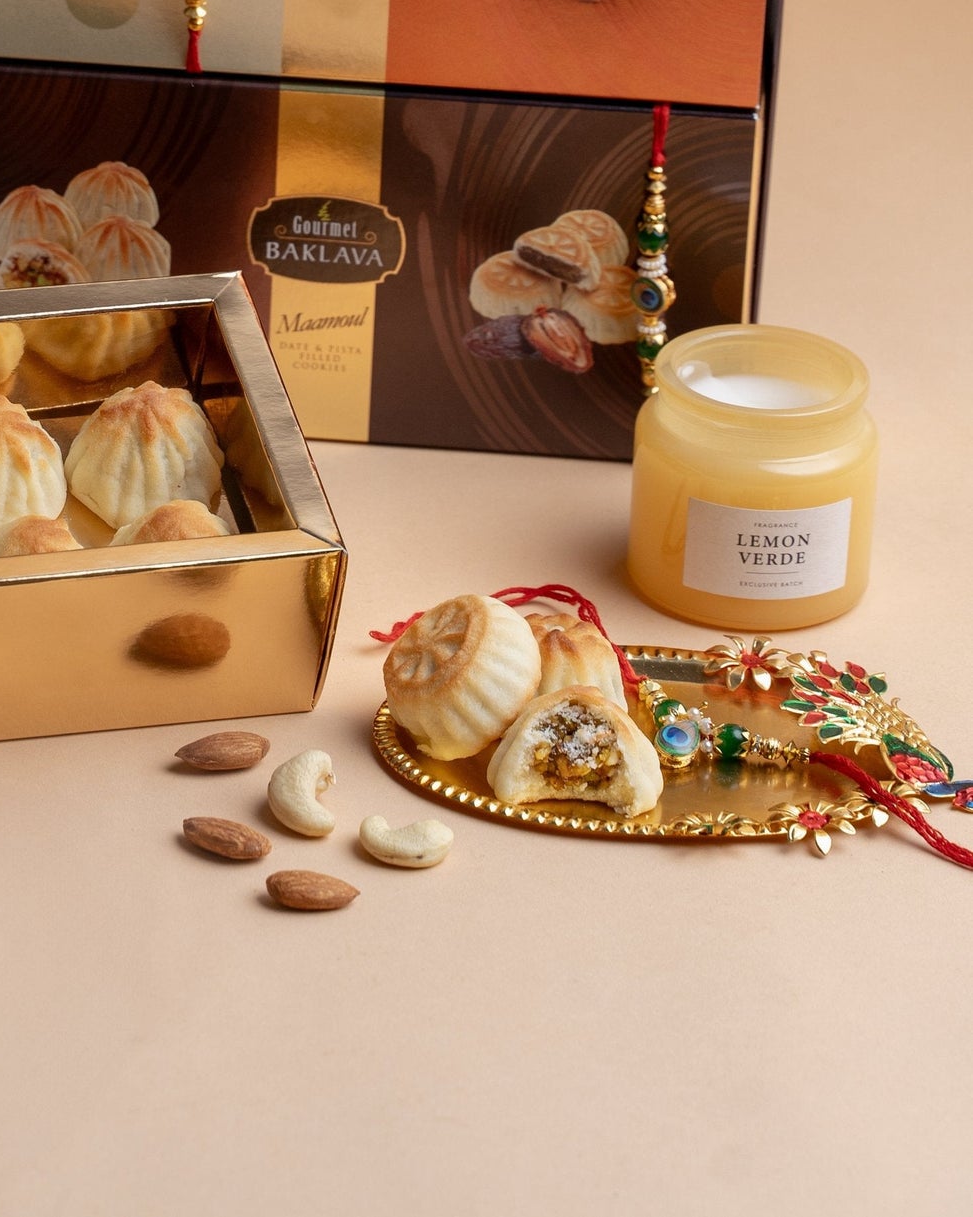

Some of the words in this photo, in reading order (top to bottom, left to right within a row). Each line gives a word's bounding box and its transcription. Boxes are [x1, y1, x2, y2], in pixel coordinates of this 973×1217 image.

[292, 215, 357, 238] Gourmet
[266, 241, 383, 267] BAKLAVA
[277, 306, 369, 334] Maamoul
[279, 341, 308, 351] DATE
[299, 352, 341, 362] FILLED
[292, 361, 346, 372] COOKIES
[736, 533, 811, 548] LEMON
[738, 551, 806, 566] VERDE
